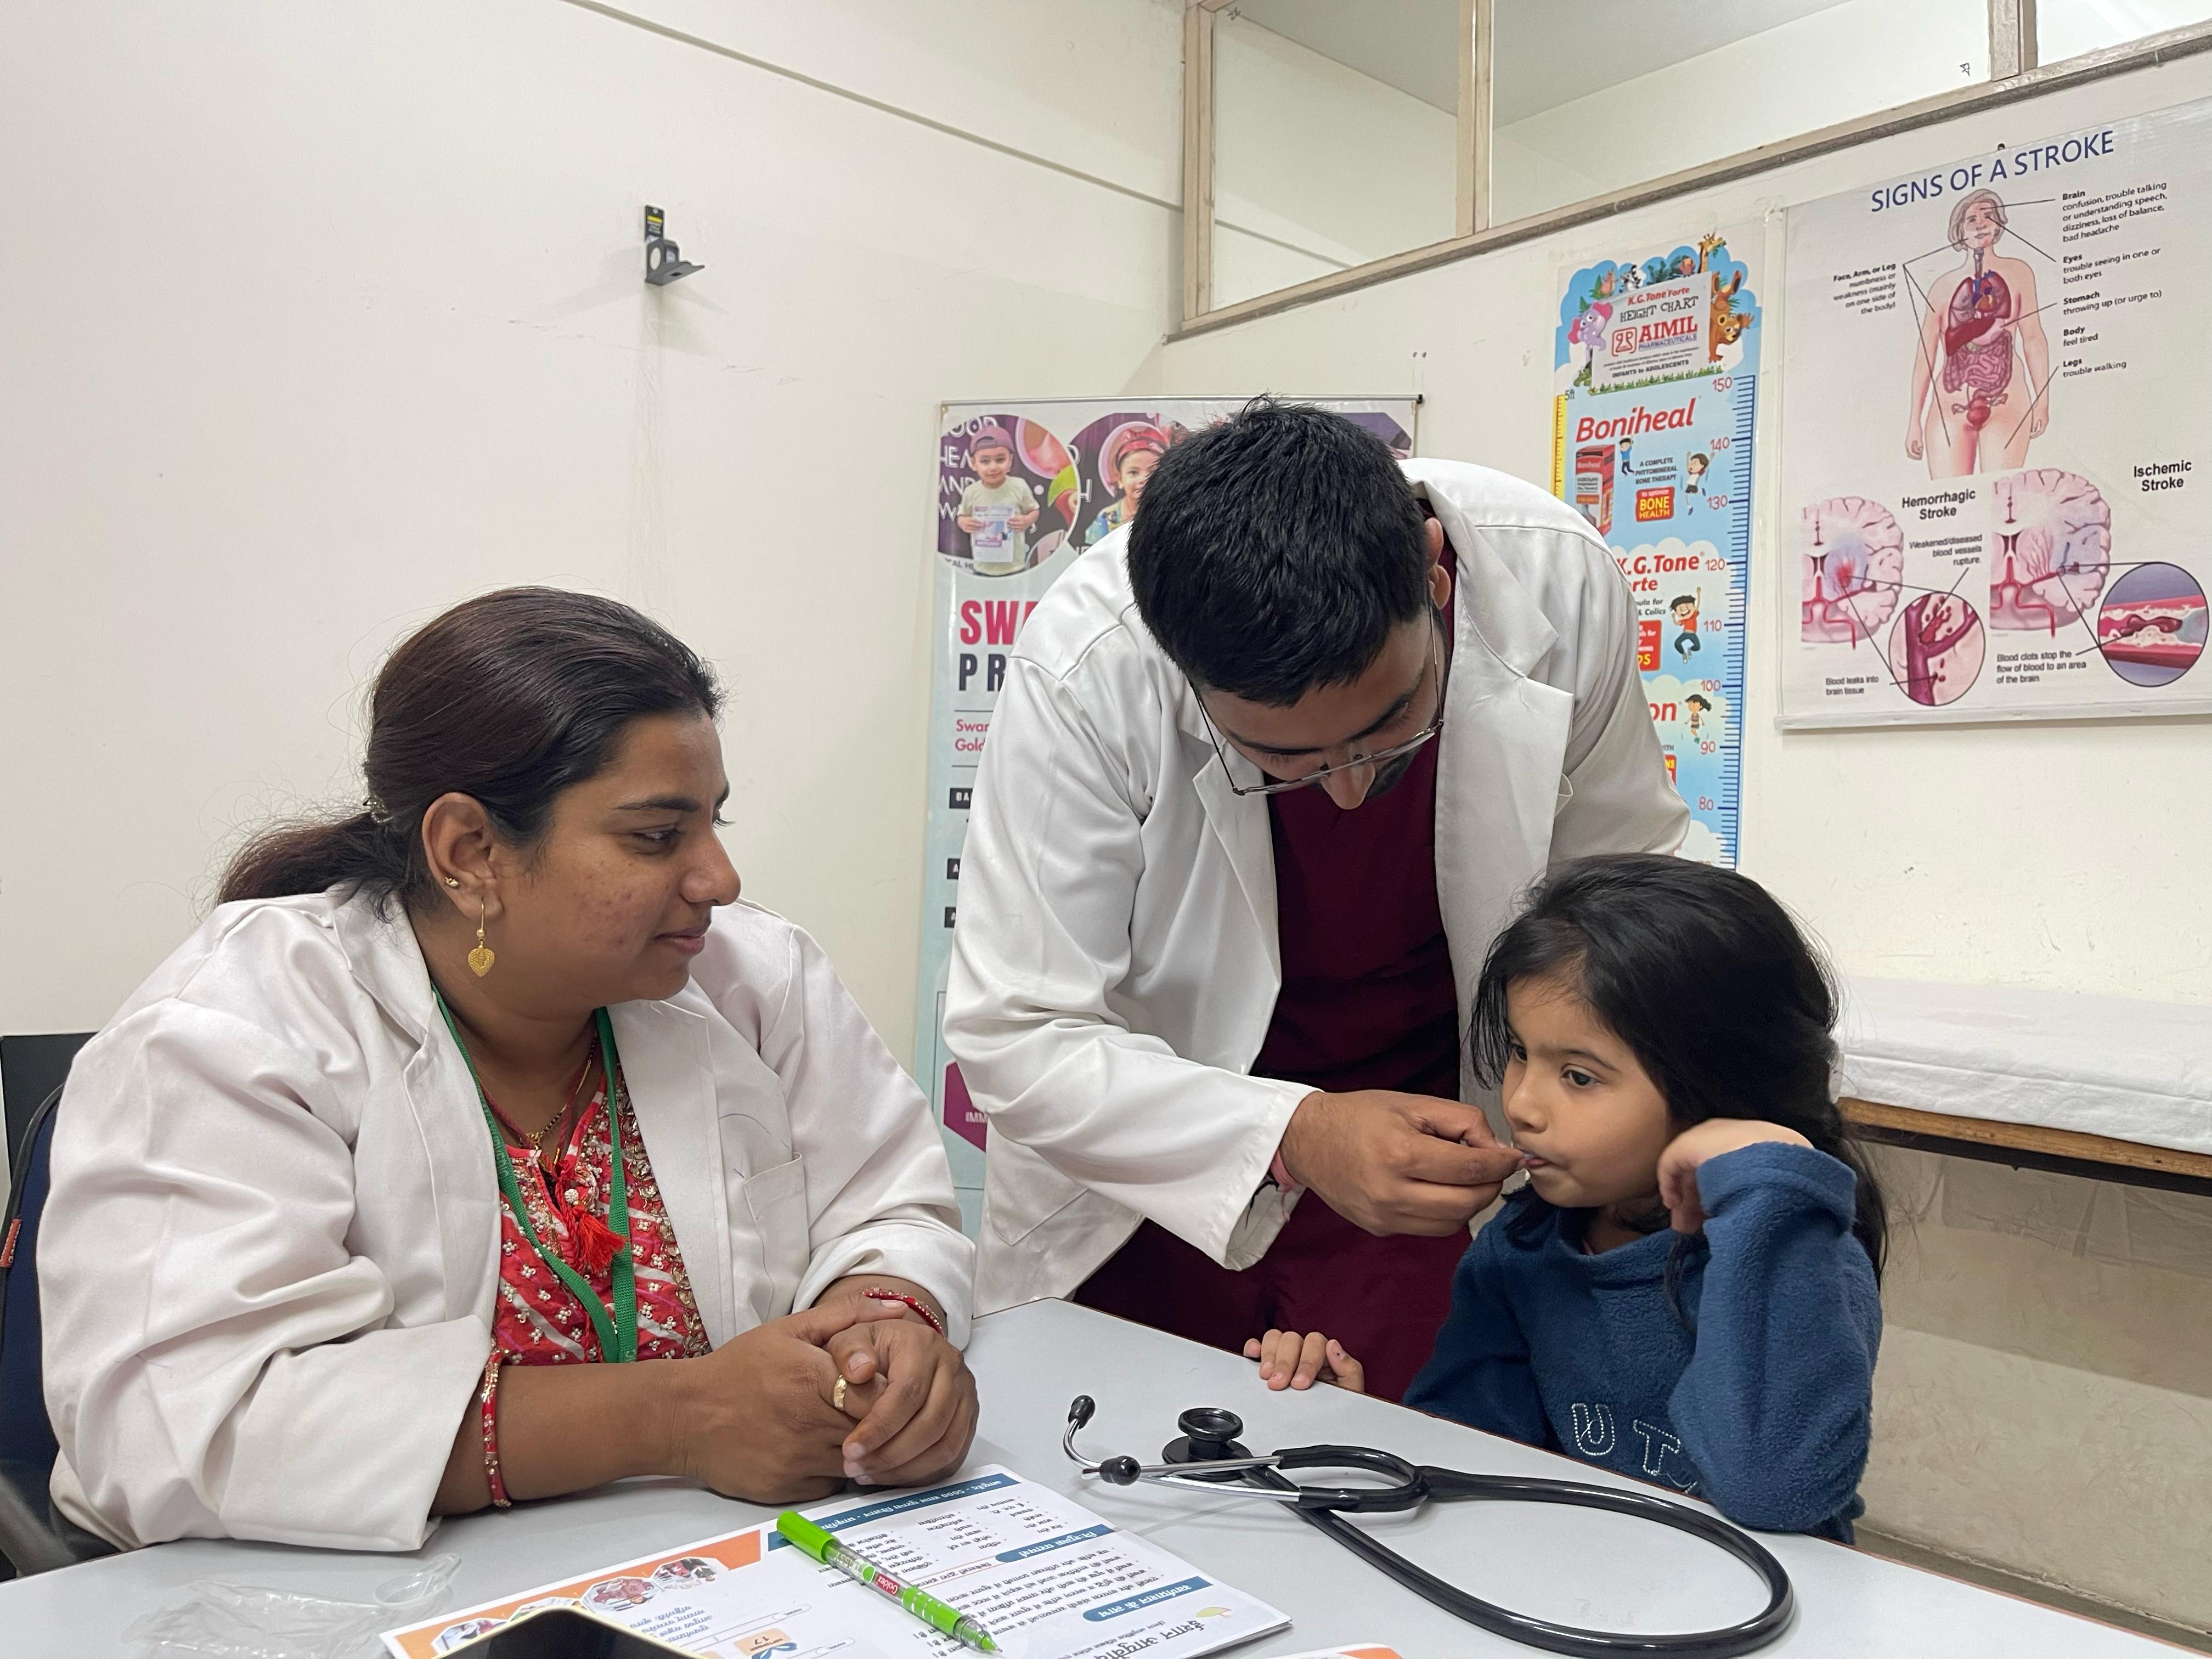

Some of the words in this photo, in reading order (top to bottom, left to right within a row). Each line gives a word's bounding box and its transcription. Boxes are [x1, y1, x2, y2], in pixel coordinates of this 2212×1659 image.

[1871, 175, 1942, 212] SIGNS
[1950, 165, 1982, 190] OF
[1990, 160, 2007, 182] A
[2015, 131, 2115, 176] STROKE
[2062, 190, 2085, 200] Brain
[2062, 196, 2104, 211] confusion,
[2106, 188, 2135, 201] trouble
[2137, 183, 2166, 194] talking
[2074, 200, 2132, 219] understanding
[2135, 193, 2167, 205] speech,
[2063, 219, 2100, 232] dizziness,
[2102, 215, 2117, 223] loss
[2119, 210, 2128, 219] of
[2129, 205, 2164, 216] balance,
[2063, 233, 2079, 242] bad
[2081, 224, 2119, 239] headache
[2063, 255, 2083, 264] Eyes
[2063, 261, 2092, 273] trouble
[2095, 256, 2120, 267] seeing
[2132, 250, 2149, 258] one
[1849, 276, 1886, 287] numbness
[2063, 274, 2083, 284] both
[2085, 270, 2102, 280] eyes
[1833, 290, 1867, 301] weakness
[2063, 291, 2100, 305] Stomach
[2063, 302, 2100, 315] throwing
[2114, 297, 2126, 306] (or
[2128, 293, 2148, 303] urge
[2150, 290, 2162, 298] to)
[1621, 304, 1656, 323] HEIGHT
[1661, 296, 1699, 312] CHART
[1639, 316, 1697, 342] AIMIL
[2063, 326, 2085, 336] Body
[1639, 334, 1696, 351] PHARMACEUTICALS
[2063, 337, 2078, 347] feel
[2080, 333, 2098, 343] tired
[1612, 369, 1637, 377] INFANTS
[1646, 359, 1689, 371] ADOLESCENTS
[2063, 358, 2082, 367] Legs
[2063, 366, 2092, 377] trouble
[2094, 362, 2126, 372] walking
[1712, 377, 1733, 392] 150
[1576, 398, 1696, 442] Boniheal
[1710, 437, 1730, 451] 140
[1646, 457, 1673, 466] COMPLETE
[2134, 460, 2193, 478] Ischemic
[2142, 477, 2184, 491] Stroke
[1640, 496, 1669, 511] BONE
[1707, 495, 1728, 510] 130
[1902, 488, 1976, 508] Hemorrhagic
[1639, 510, 1669, 519] HEALTH
[1920, 506, 1957, 520] Stroke
[1932, 548, 1953, 557] blood
[1955, 545, 1982, 555] vessels
[1705, 559, 1725, 570] 120
[1703, 620, 1722, 631] 110
[1997, 653, 2018, 662] Blood
[2041, 652, 2057, 660] stop
[2023, 663, 2044, 671] blood
[1701, 680, 1720, 691] 100
[1701, 741, 1716, 754] 90
[1699, 797, 1714, 810] 80
[941, 1489, 964, 1498] 5000
[893, 1498, 921, 1510] पुराना
[863, 1506, 893, 1517] विज्ञान
[1019, 1544, 1054, 1558] परामर्श
[877, 1576, 898, 1594] Goldex
[1098, 1606, 1125, 1617] लाभ
[1160, 1620, 1205, 1640] ईशान
